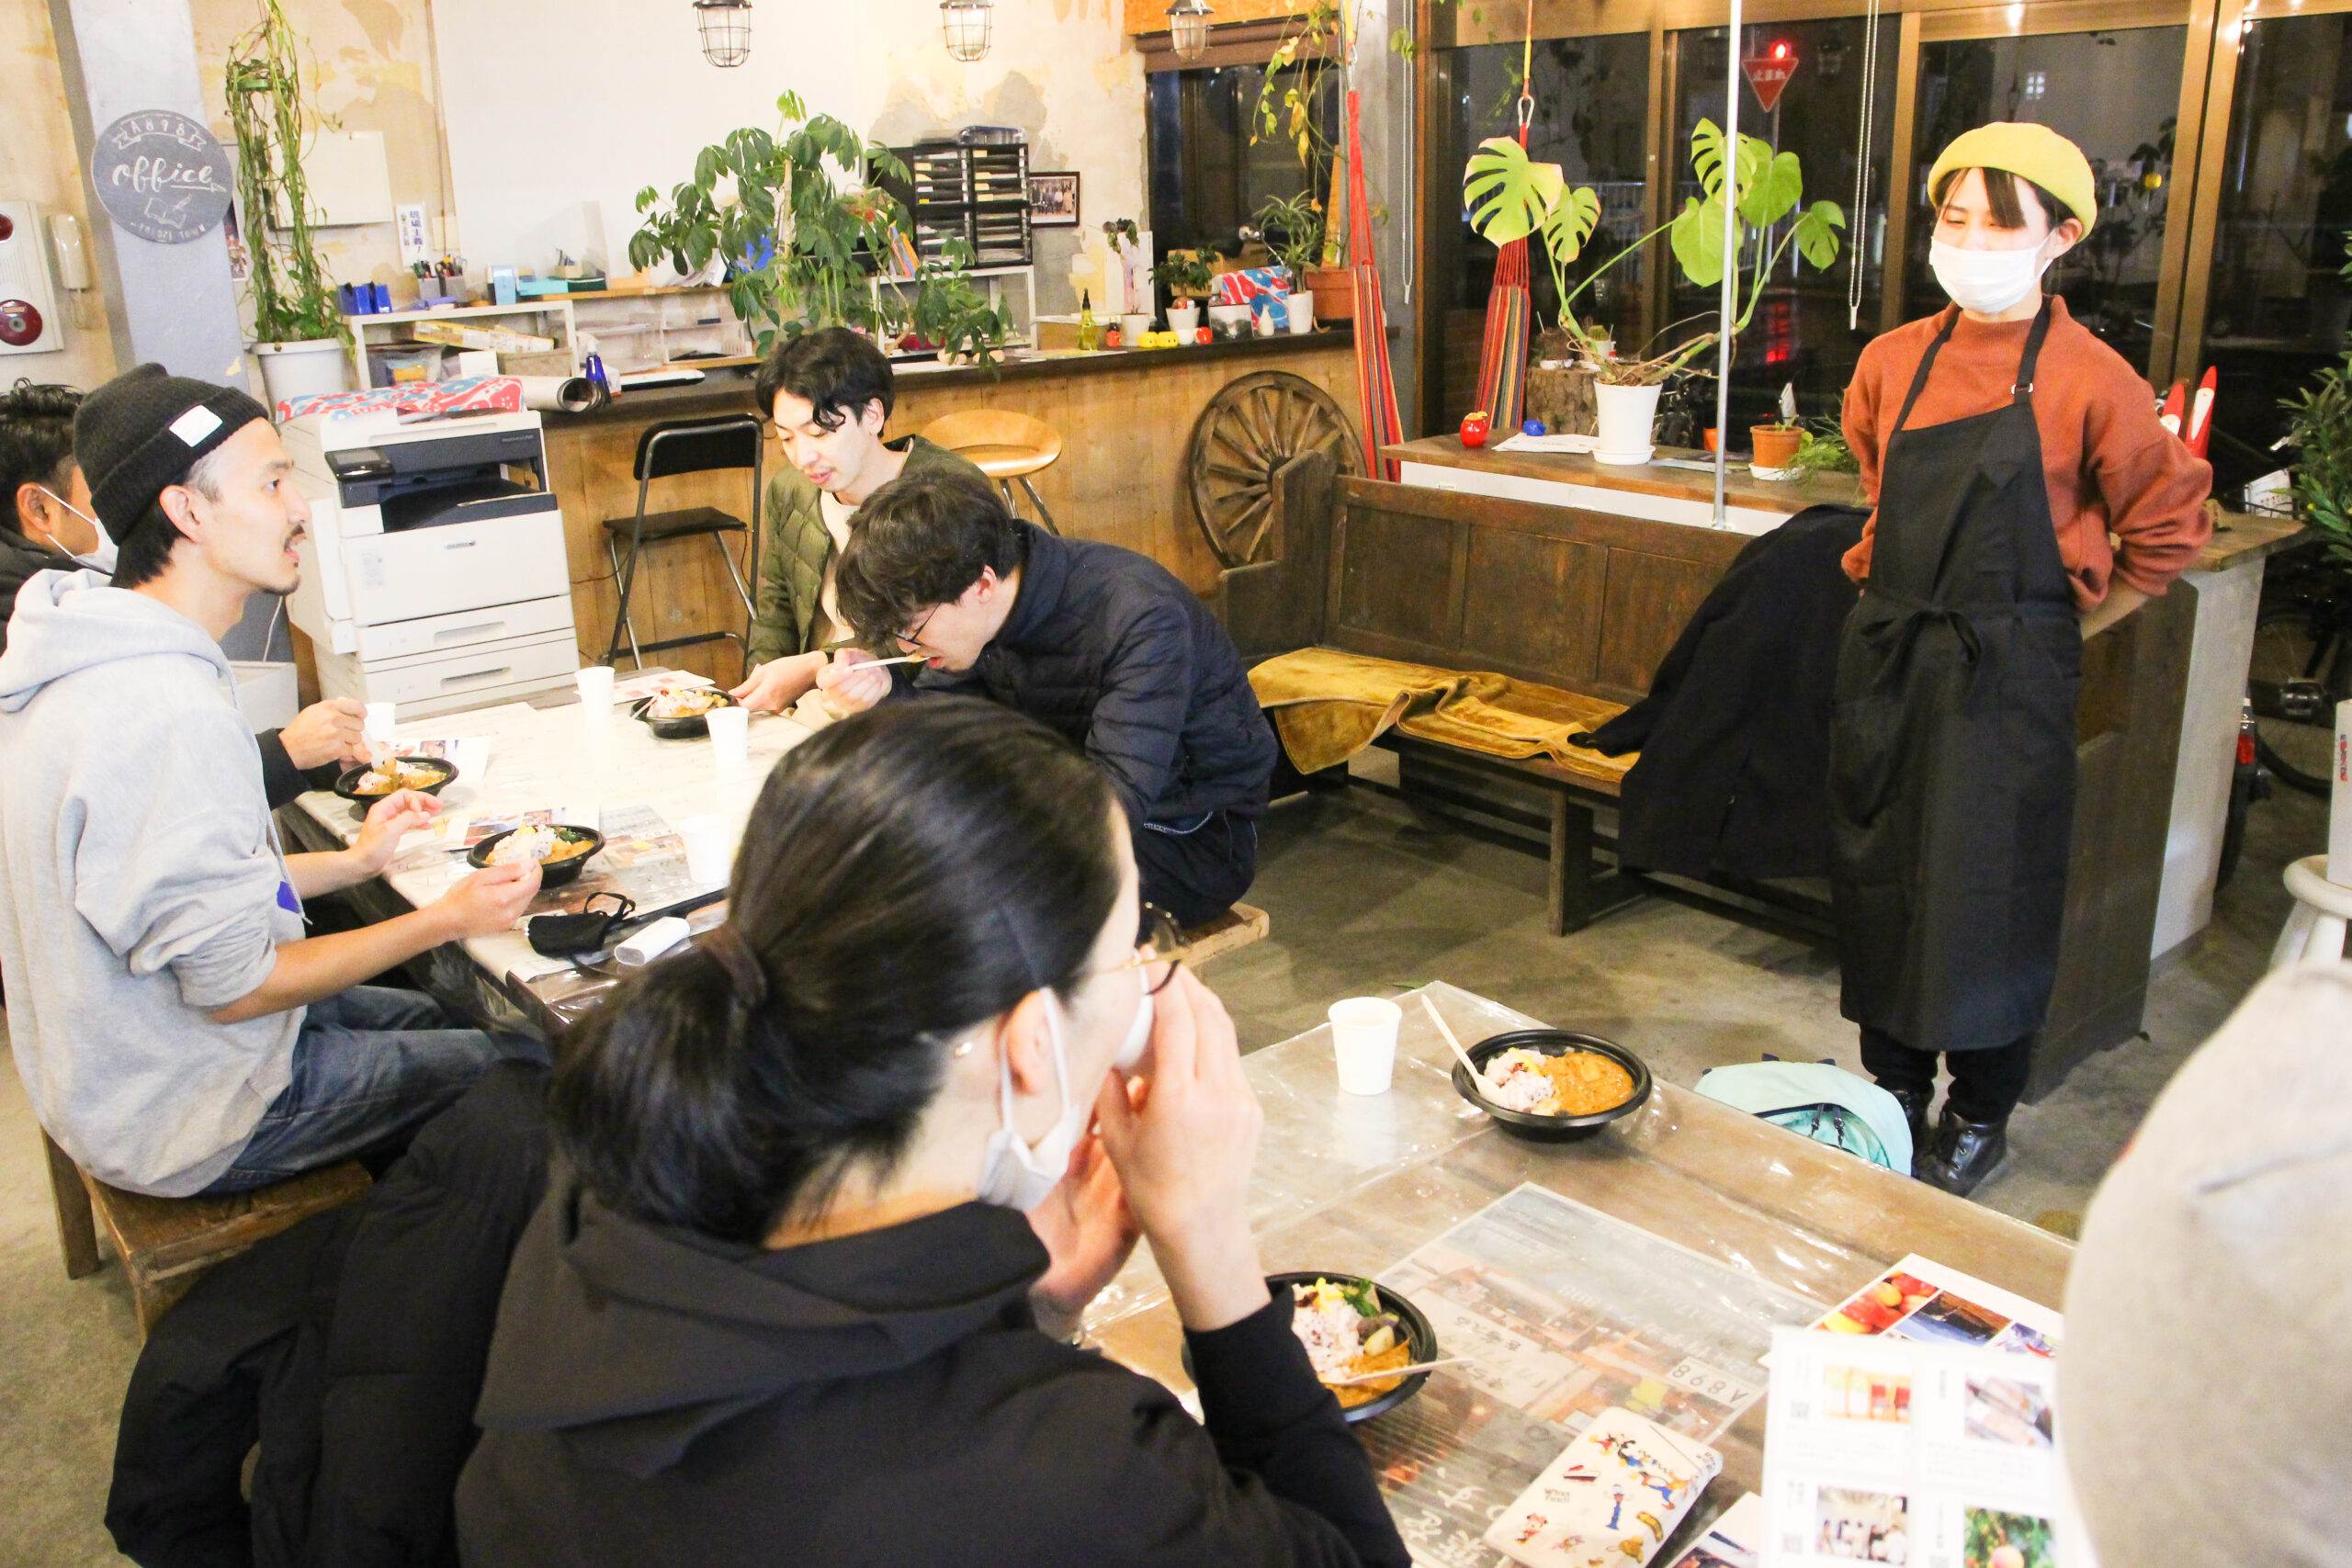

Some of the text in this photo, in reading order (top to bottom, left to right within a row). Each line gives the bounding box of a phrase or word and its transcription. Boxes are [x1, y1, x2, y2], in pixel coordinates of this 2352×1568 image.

[1753, 68, 1787, 81] 止まれ
[130, 118, 186, 135] A898
[111, 155, 212, 193] office
[1672, 1364, 1750, 1403] A898
